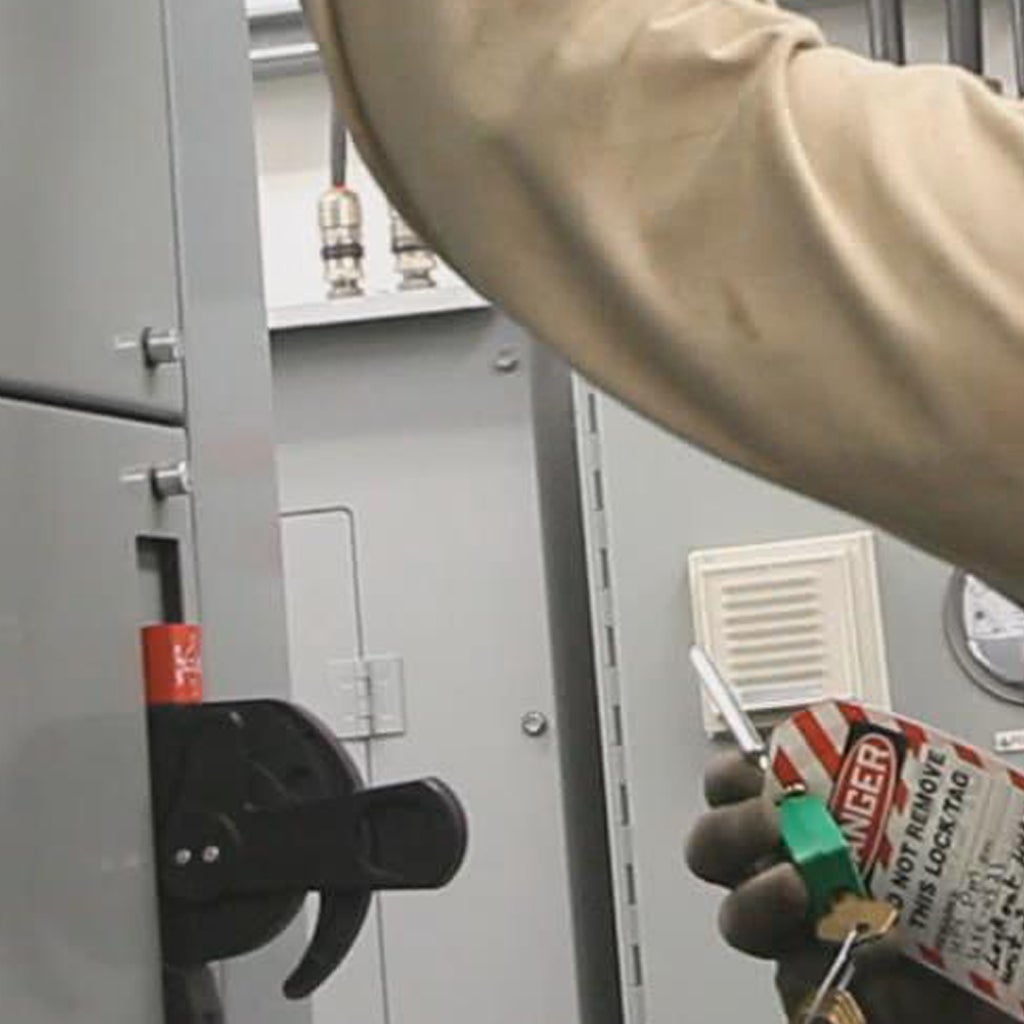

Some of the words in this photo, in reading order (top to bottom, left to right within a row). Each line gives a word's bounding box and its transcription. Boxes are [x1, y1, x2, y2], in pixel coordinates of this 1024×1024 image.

[841, 743, 891, 864] ANGER
[905, 749, 946, 842] REMOVE
[889, 842, 918, 890] NOT
[886, 892, 904, 911] O
[908, 880, 937, 928] THIS
